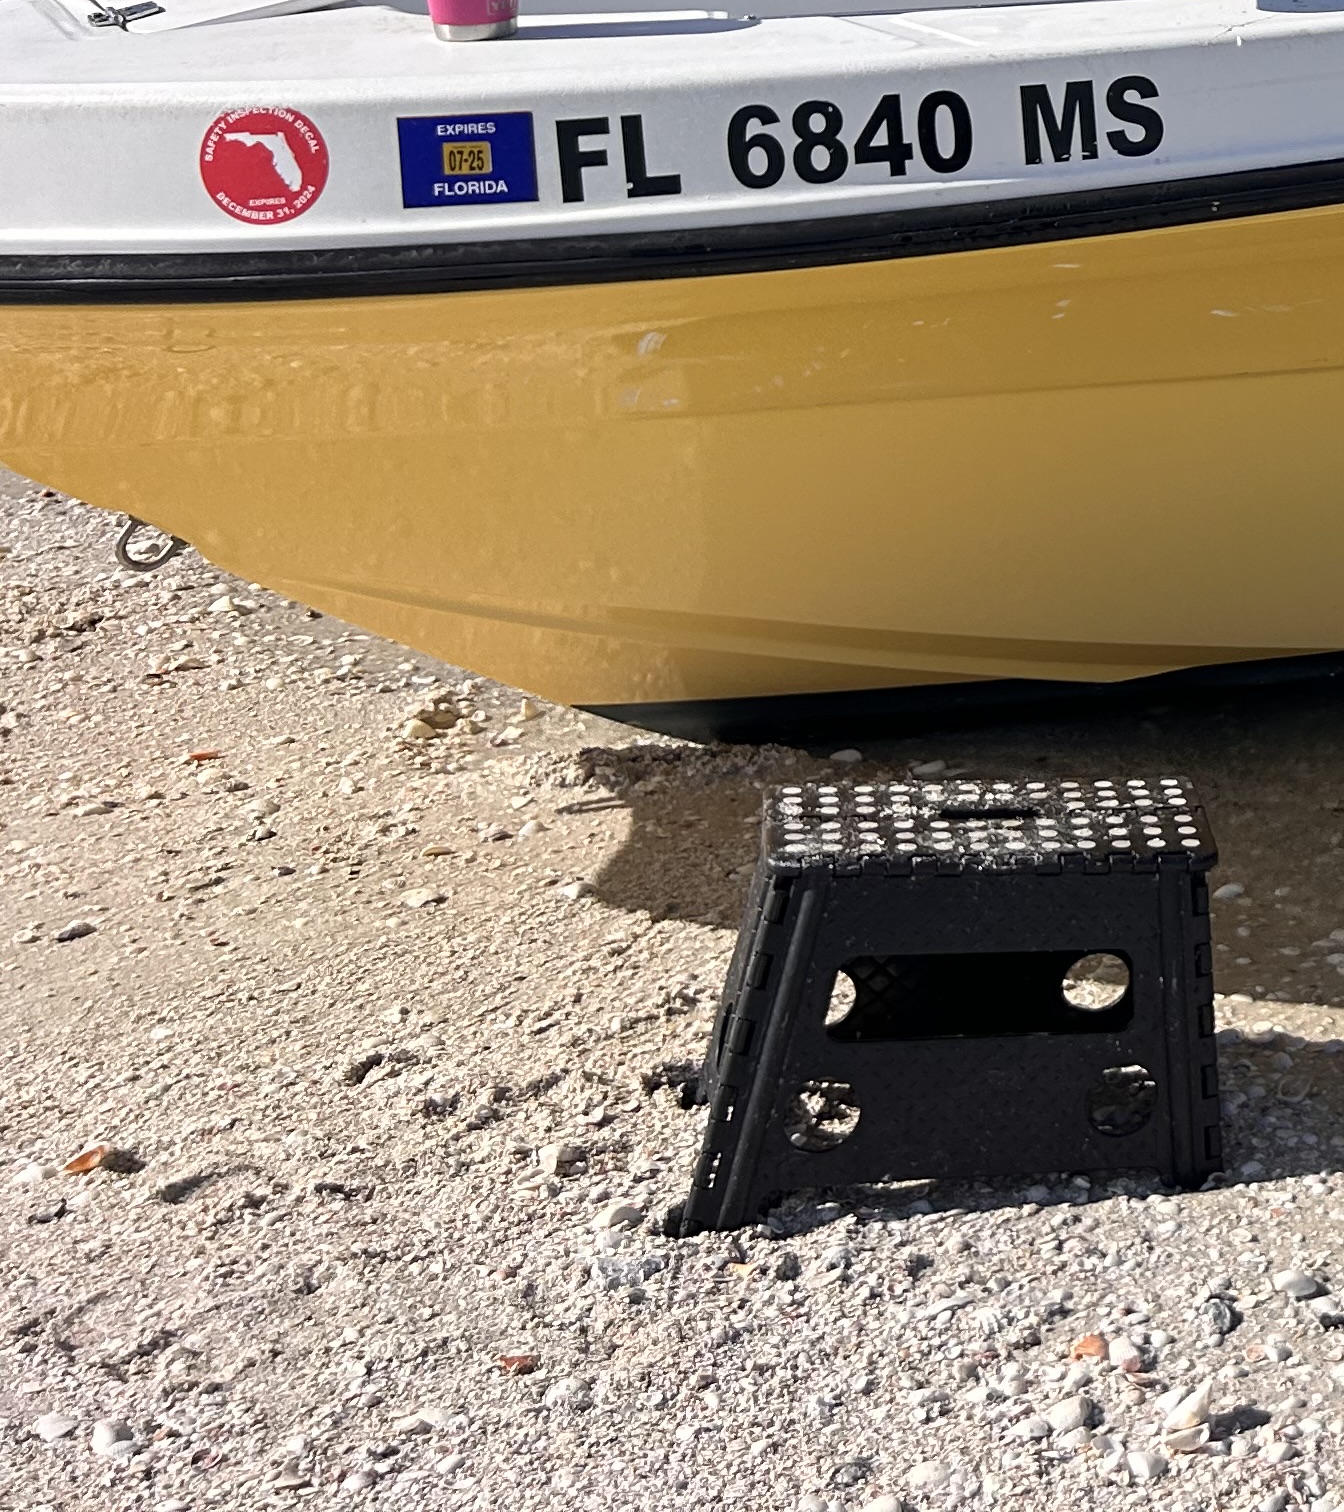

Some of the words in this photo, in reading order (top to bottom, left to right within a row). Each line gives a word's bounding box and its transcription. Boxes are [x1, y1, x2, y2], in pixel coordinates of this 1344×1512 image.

[204, 121, 227, 162] SAFETY
[226, 106, 295, 123] INSPECTION
[294, 119, 320, 154] DECAL
[437, 122, 496, 136] EXPIRES
[555, 114, 682, 203] FL
[727, 89, 973, 188] 6840
[1018, 75, 1164, 165] MS
[449, 149, 484, 172] 07-25
[433, 180, 508, 196] FLORIDA
[216, 191, 274, 220] DECEMBER
[293, 185, 316, 209] 2024
[249, 197, 286, 207] EXPIRES
